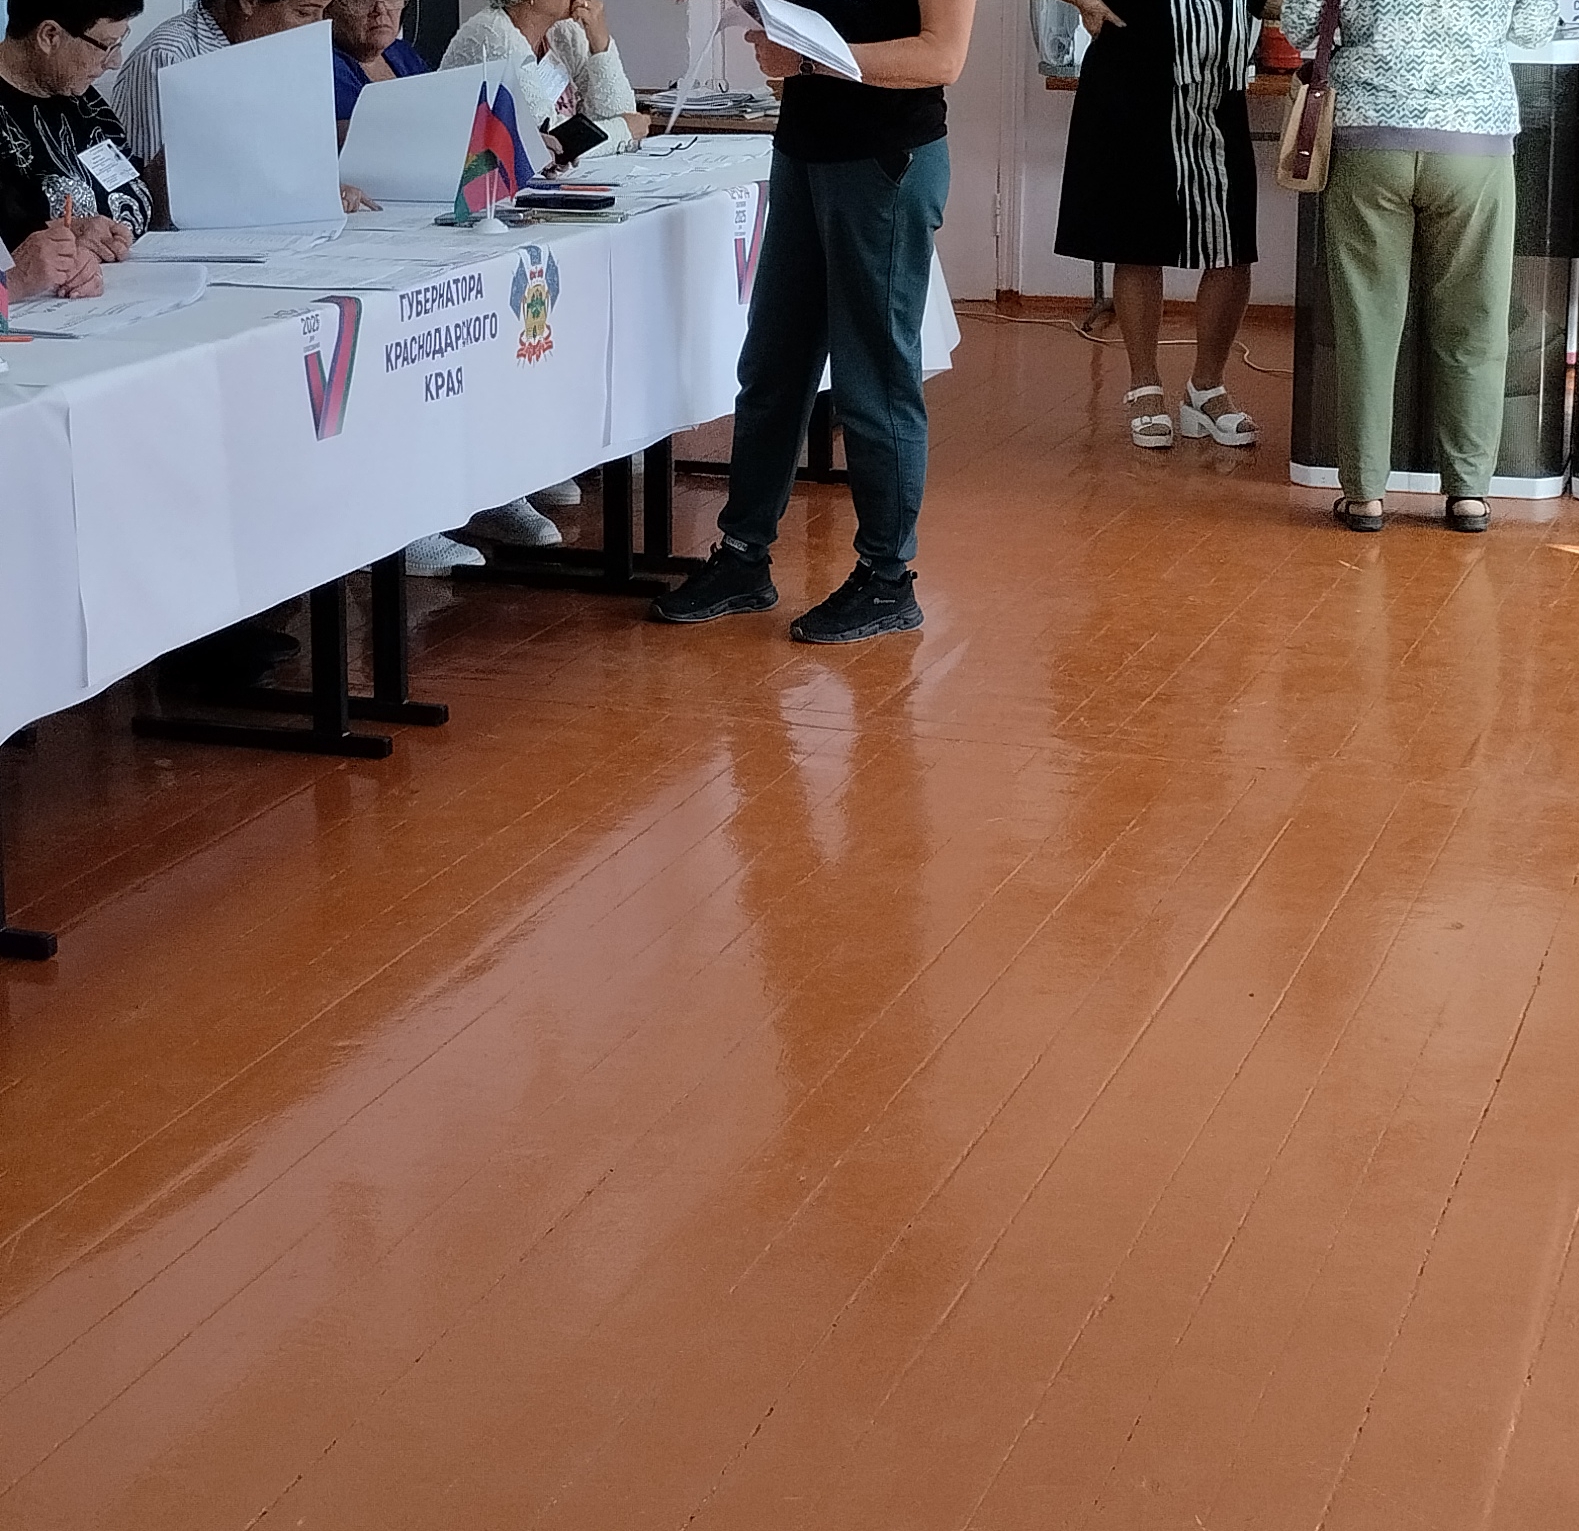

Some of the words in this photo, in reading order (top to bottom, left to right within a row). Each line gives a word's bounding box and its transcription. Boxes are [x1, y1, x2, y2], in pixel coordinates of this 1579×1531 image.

[399, 273, 483, 322] ГУБЕРНАТОРА
[301, 313, 320, 335] 2025
[385, 312, 498, 373] КРАСНОДАРСКОГО
[425, 366, 463, 402] КРАЯ
